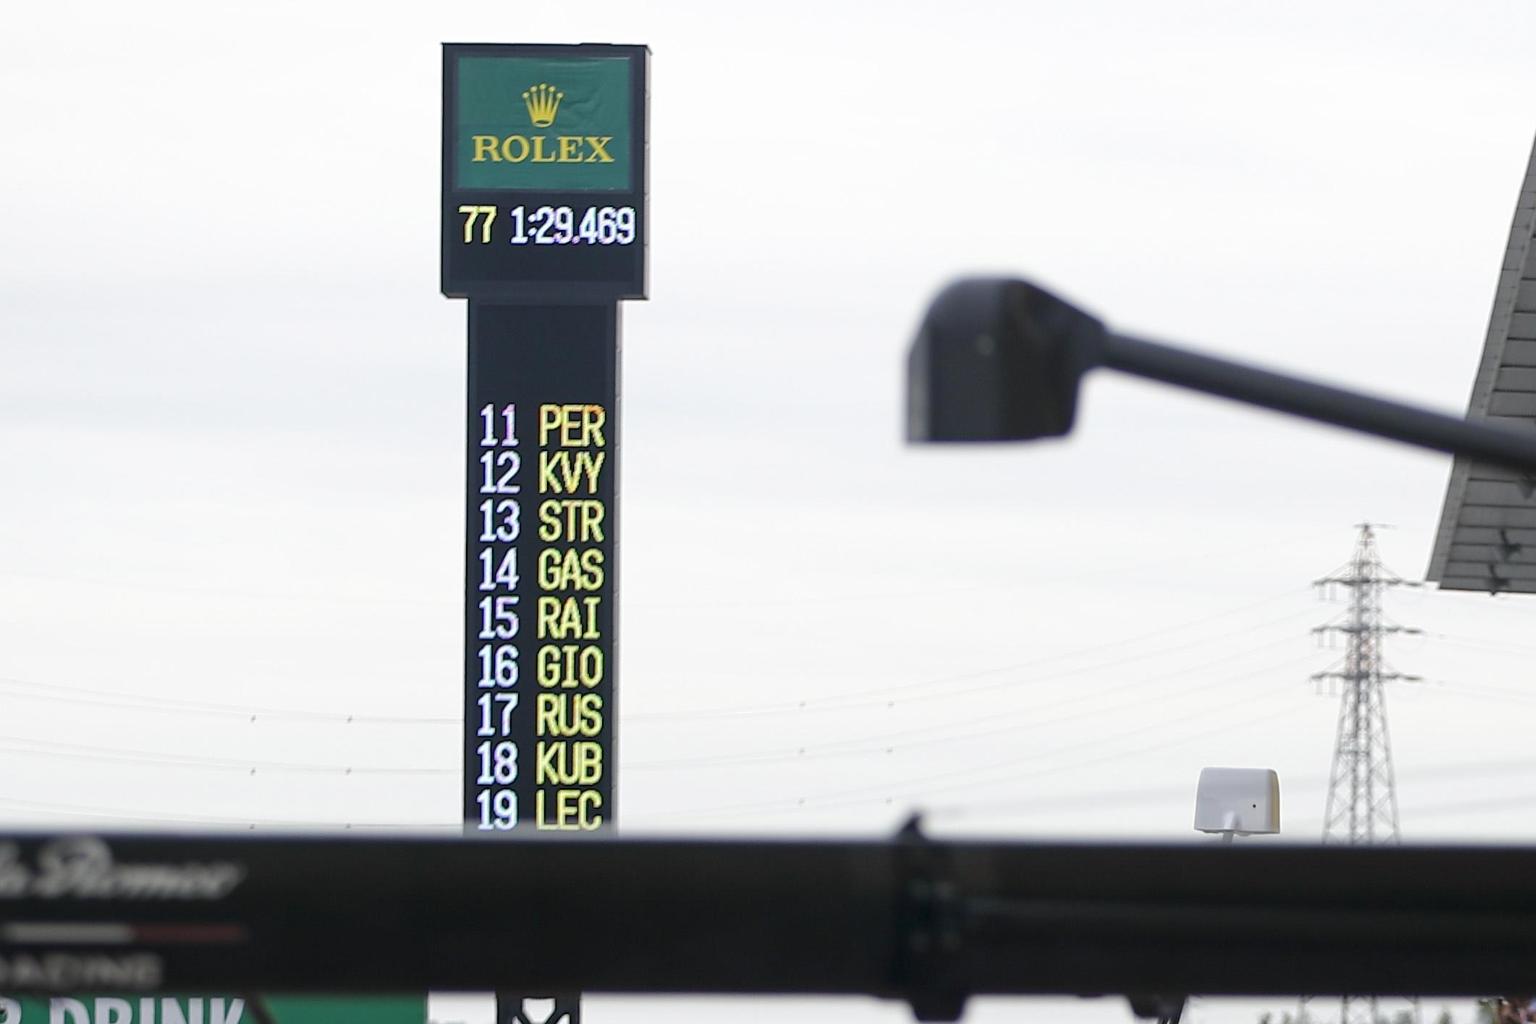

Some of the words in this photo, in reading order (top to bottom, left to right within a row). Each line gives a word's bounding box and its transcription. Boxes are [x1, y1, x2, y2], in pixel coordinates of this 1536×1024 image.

[471, 135, 615, 163] ROLEX
[458, 206, 497, 243] 77
[511, 206, 636, 244] 1:29.469
[480, 404, 519, 447] 11
[538, 404, 606, 447] PER
[480, 451, 520, 494] 12
[538, 451, 605, 494] KVY
[479, 499, 520, 542] 13
[538, 499, 605, 542] STR
[479, 547, 519, 591] 14
[537, 548, 605, 591] GAS
[478, 596, 519, 639] 15
[537, 596, 600, 639] RAI
[478, 644, 518, 688] 16
[537, 644, 603, 687] GIO
[477, 693, 518, 736] 17
[536, 693, 602, 736] RUS
[477, 741, 518, 785] 18
[536, 741, 602, 784] KUB
[477, 789, 518, 830] 19
[535, 789, 602, 830] LEC
